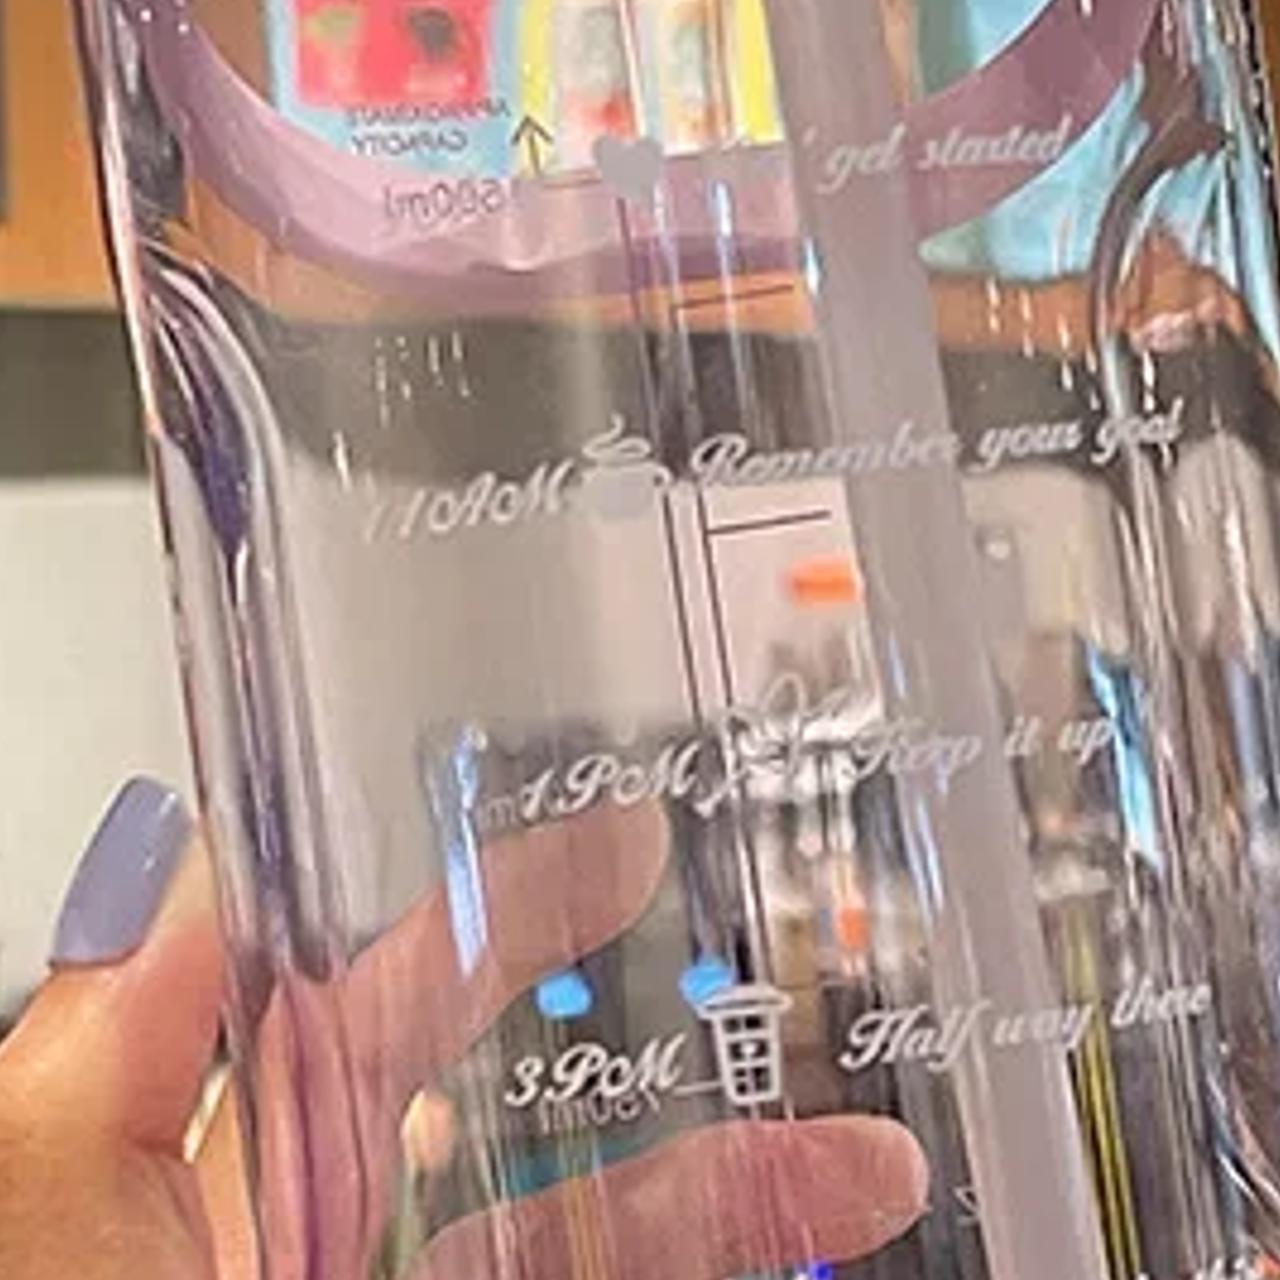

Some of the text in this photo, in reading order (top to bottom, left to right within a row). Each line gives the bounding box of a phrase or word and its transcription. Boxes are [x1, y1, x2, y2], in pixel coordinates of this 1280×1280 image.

[816, 122, 908, 196] get
[688, 419, 962, 486] Remember
[967, 418, 1085, 473] your
[839, 996, 992, 1071] Half
